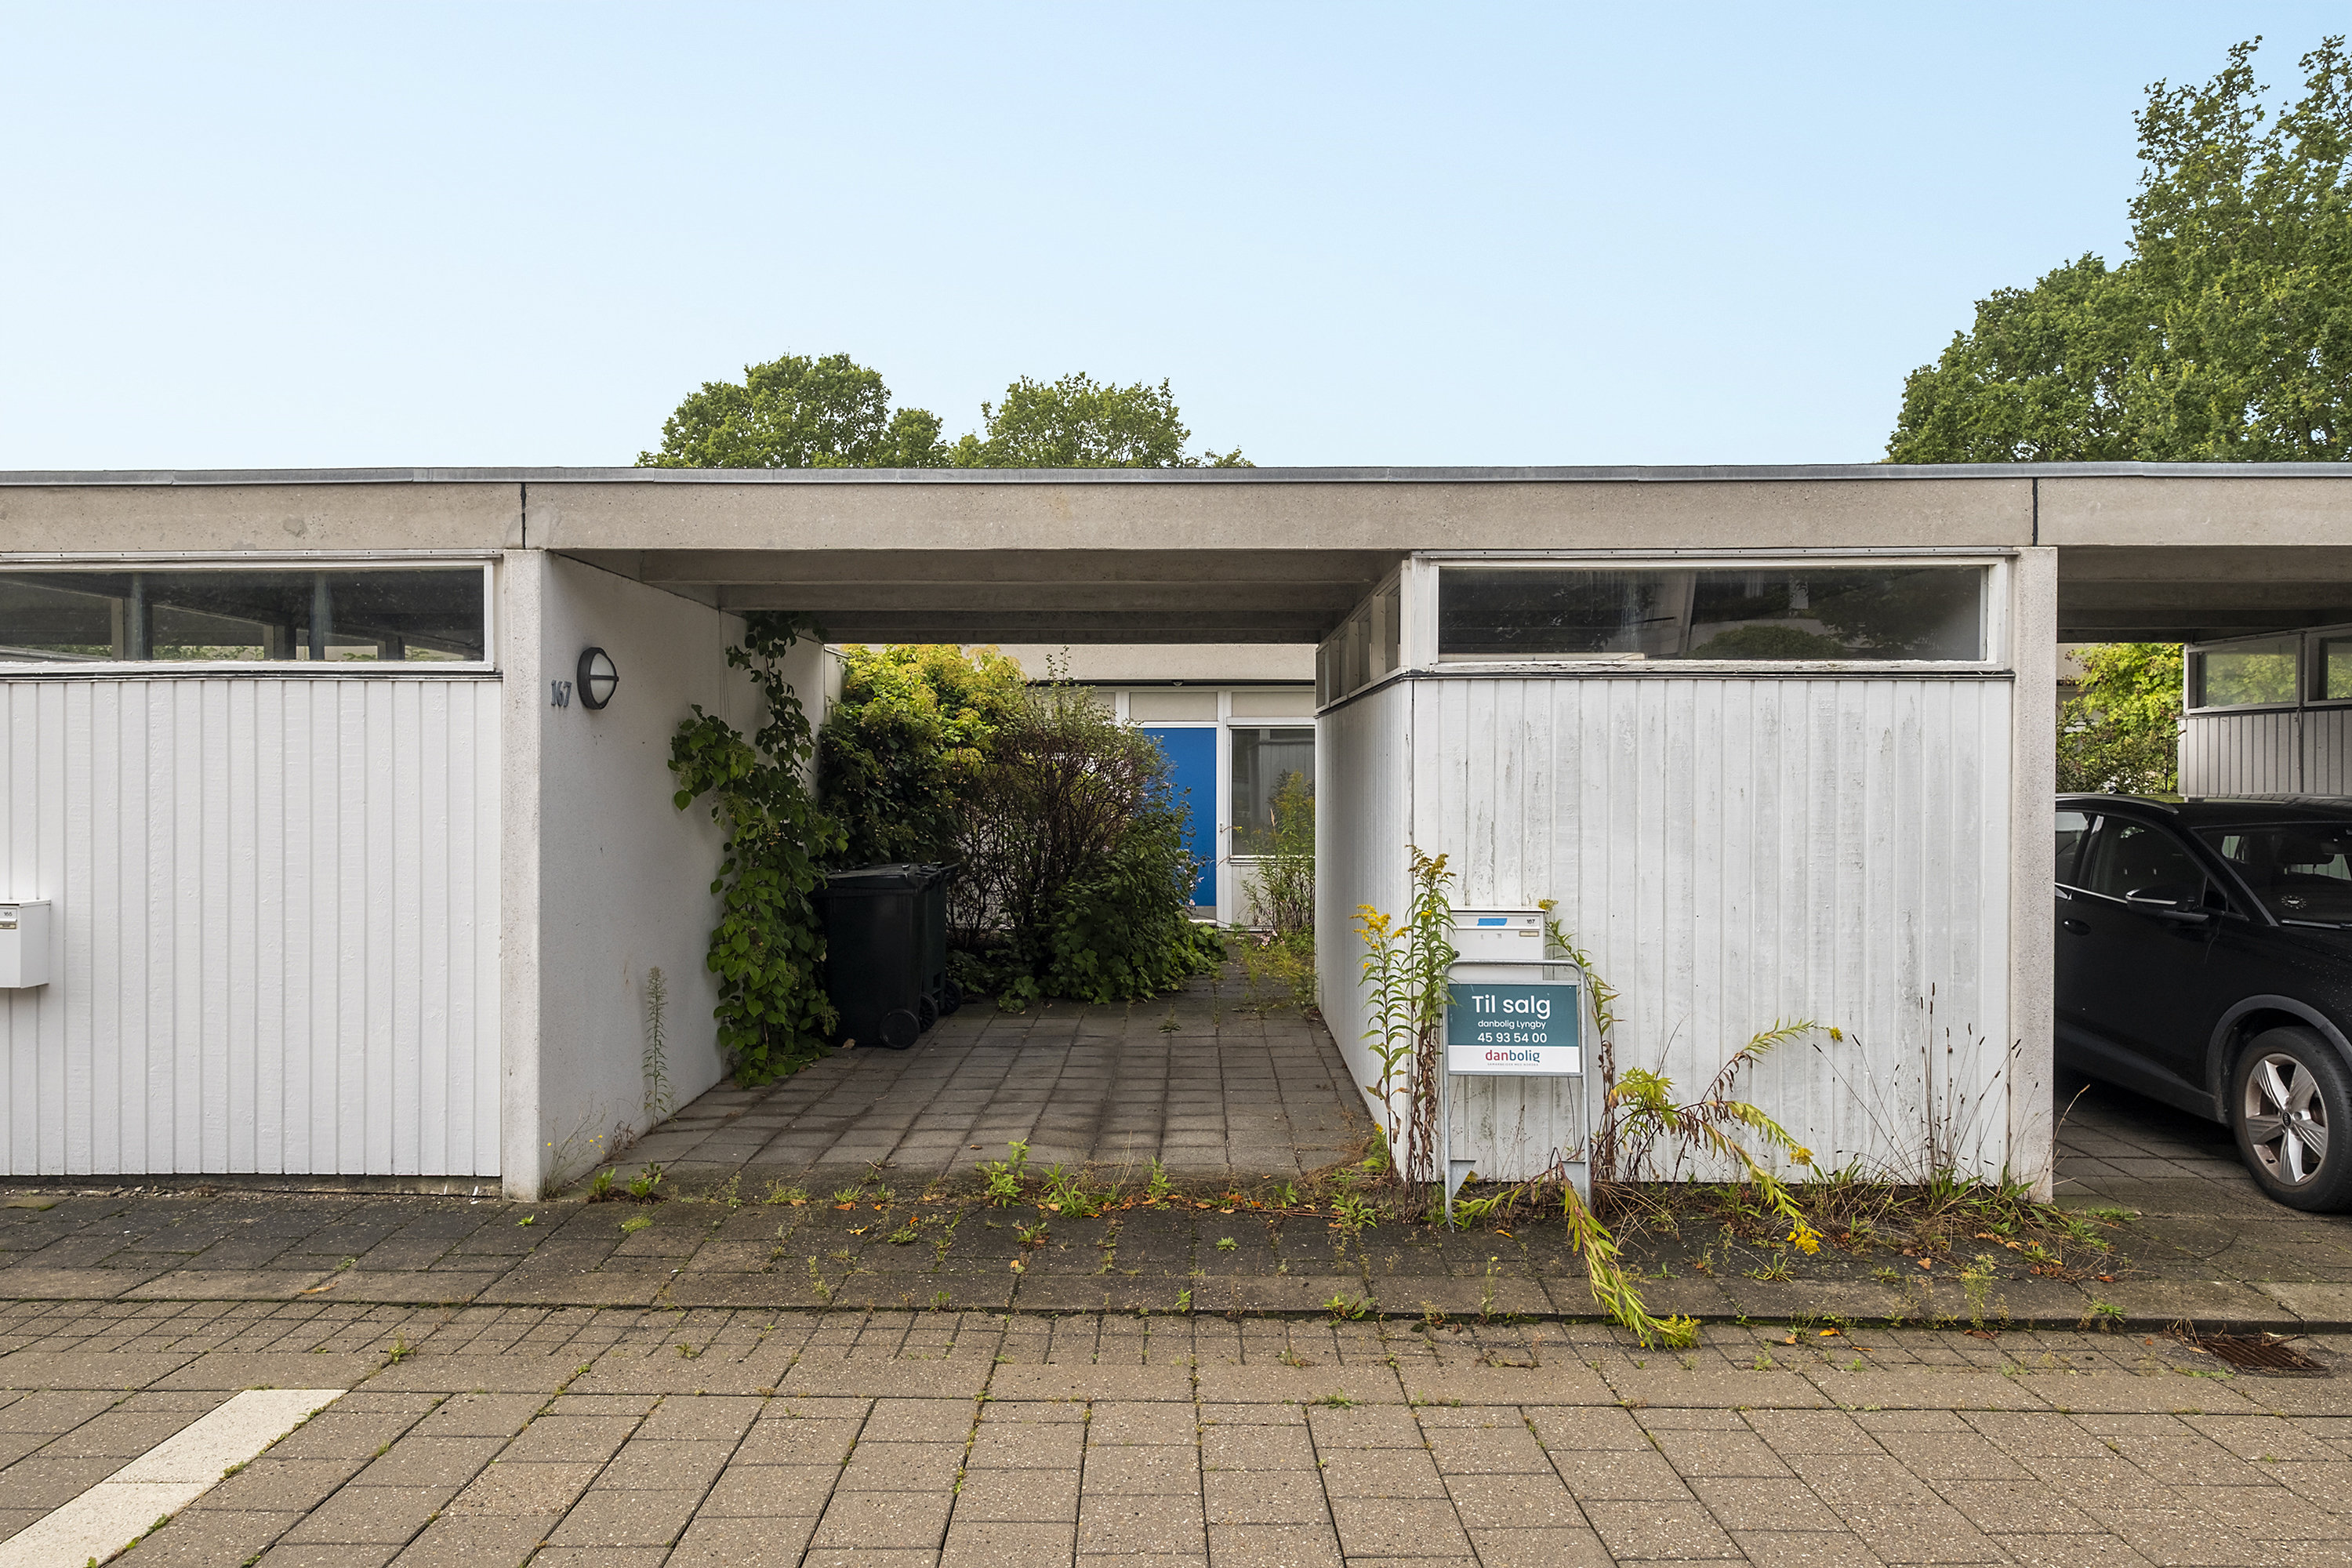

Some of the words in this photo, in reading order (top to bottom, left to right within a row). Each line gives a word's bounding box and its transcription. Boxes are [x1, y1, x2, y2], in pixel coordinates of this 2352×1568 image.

[551, 680, 572, 706] 167
[1472, 994, 1496, 1013] Til
[1503, 995, 1551, 1019] salg
[1478, 1020, 1515, 1029] danbolig
[1516, 1020, 1546, 1029] Lyngby
[1477, 1033, 1493, 1043] 45
[1496, 1033, 1510, 1043] 93
[1514, 1033, 1529, 1043] 54
[1532, 1033, 1548, 1043] 00
[1485, 1049, 1540, 1062] danbolig
